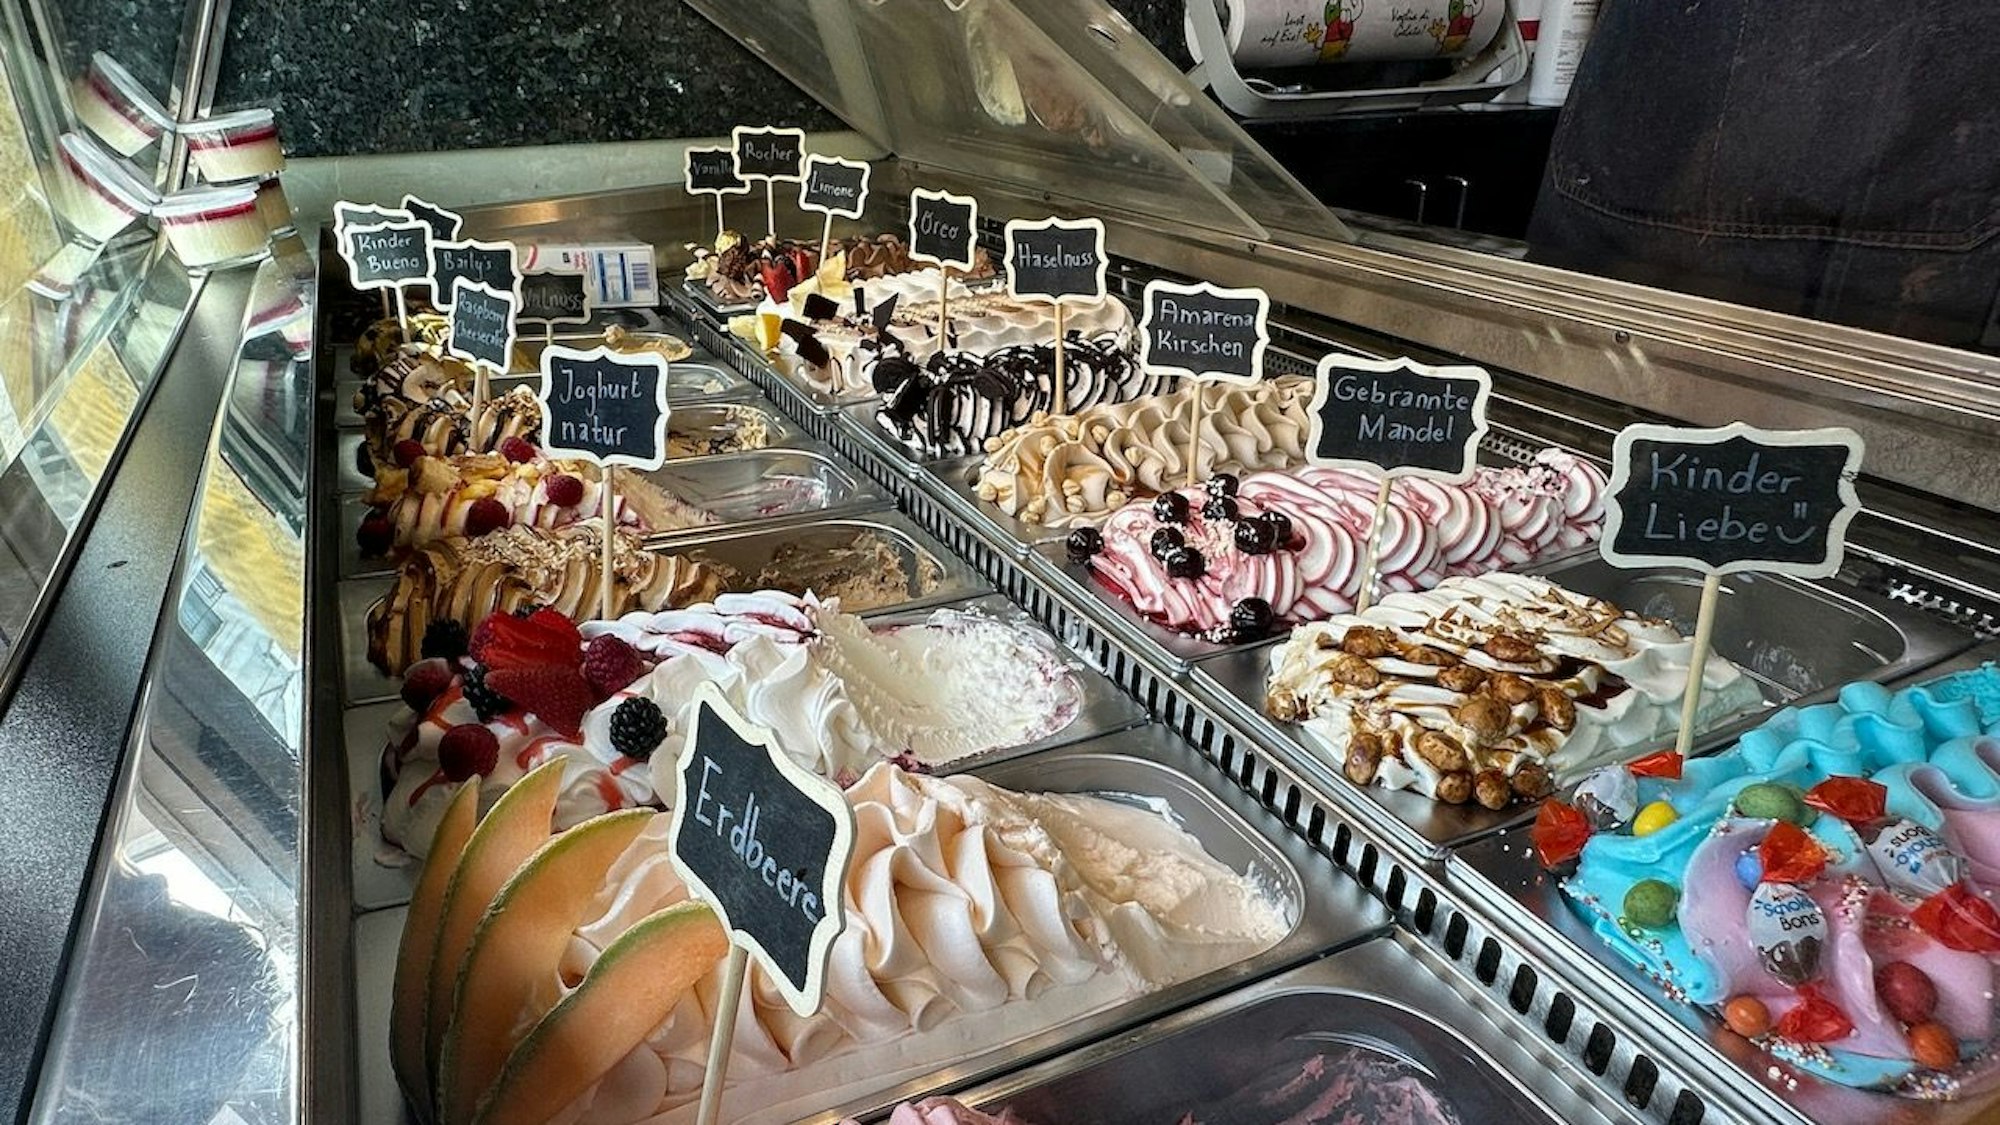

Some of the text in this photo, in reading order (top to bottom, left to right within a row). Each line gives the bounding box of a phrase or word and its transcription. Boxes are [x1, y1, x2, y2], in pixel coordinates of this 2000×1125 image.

[745, 141, 793, 161] Rocher
[692, 158, 732, 176] Vanill
[810, 170, 854, 198] Limone
[921, 209, 959, 239] Oreo
[358, 232, 412, 253] Kinder
[1017, 243, 1093, 269] Haselnuss
[367, 255, 419, 273] Bueno
[1160, 299, 1253, 328] Amarena
[1157, 329, 1245, 358] Kirschen
[559, 367, 643, 417] Joghurt
[1333, 374, 1469, 411] Gebrannte
[561, 414, 628, 447] natur
[1357, 413, 1454, 443] Mandel
[1650, 451, 1803, 494] Kinder
[1644, 502, 1769, 543] Liebe
[694, 754, 818, 924] Erdbeere
[1780, 913, 1820, 931] Bons
